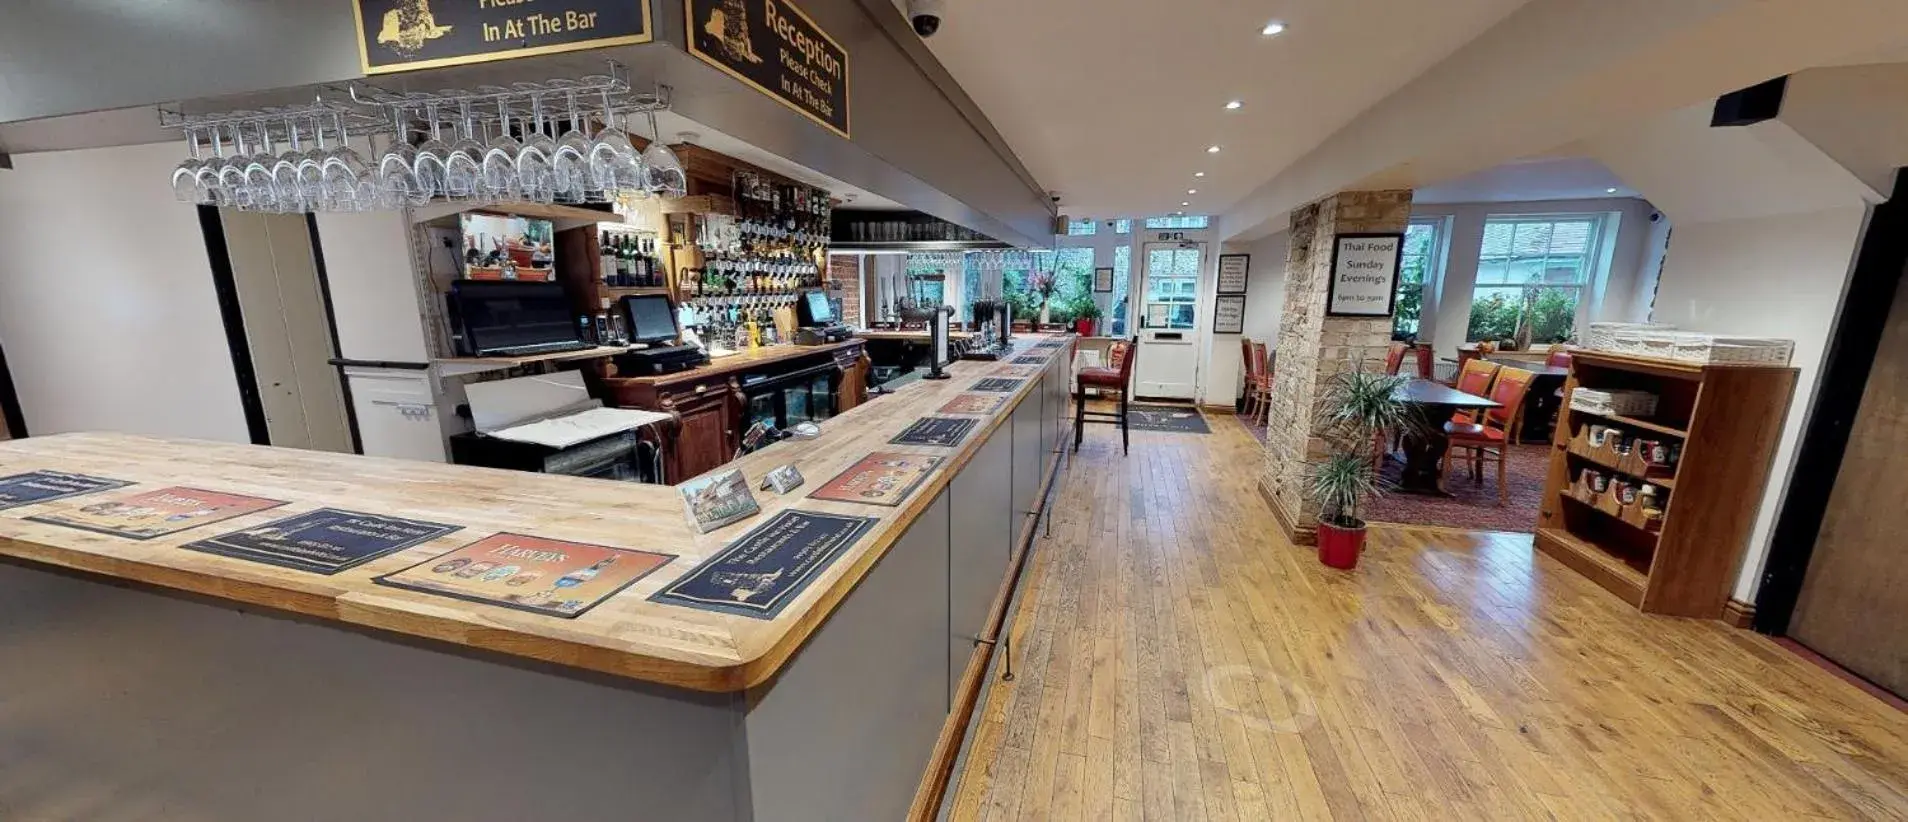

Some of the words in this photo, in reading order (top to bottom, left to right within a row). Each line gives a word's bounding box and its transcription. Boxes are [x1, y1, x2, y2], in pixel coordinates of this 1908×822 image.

[483, 23, 500, 42] In
[504, 19, 525, 39] At
[527, 13, 561, 35] The
[565, 10, 597, 31] Bar
[765, 0, 841, 80] Reception
[780, 48, 809, 79] Please
[809, 69, 832, 96] Check
[781, 74, 791, 93] In
[791, 82, 802, 100] At
[803, 88, 819, 109] The
[820, 99, 833, 117] Bar
[1344, 243, 1366, 252] Thai
[1368, 243, 1394, 252] Food
[1340, 274, 1386, 285] Evenings
[1347, 260, 1384, 270] Sunday
